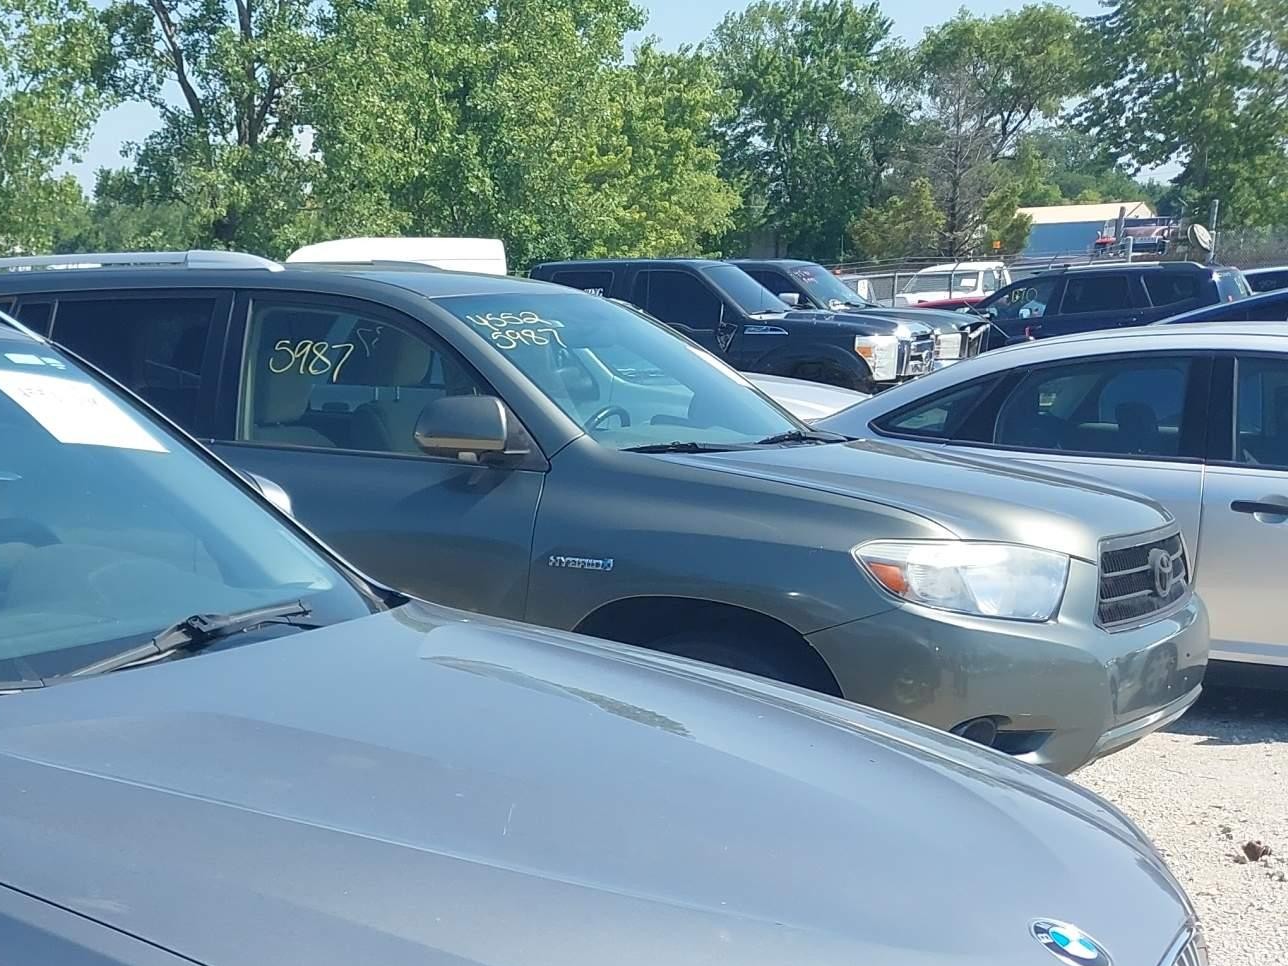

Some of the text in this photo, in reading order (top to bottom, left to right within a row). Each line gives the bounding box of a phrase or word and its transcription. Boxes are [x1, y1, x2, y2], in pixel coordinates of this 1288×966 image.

[465, 311, 553, 331] 4552
[491, 327, 568, 350] 5987
[268, 340, 355, 384] 5987
[548, 555, 603, 570] HYBRID
